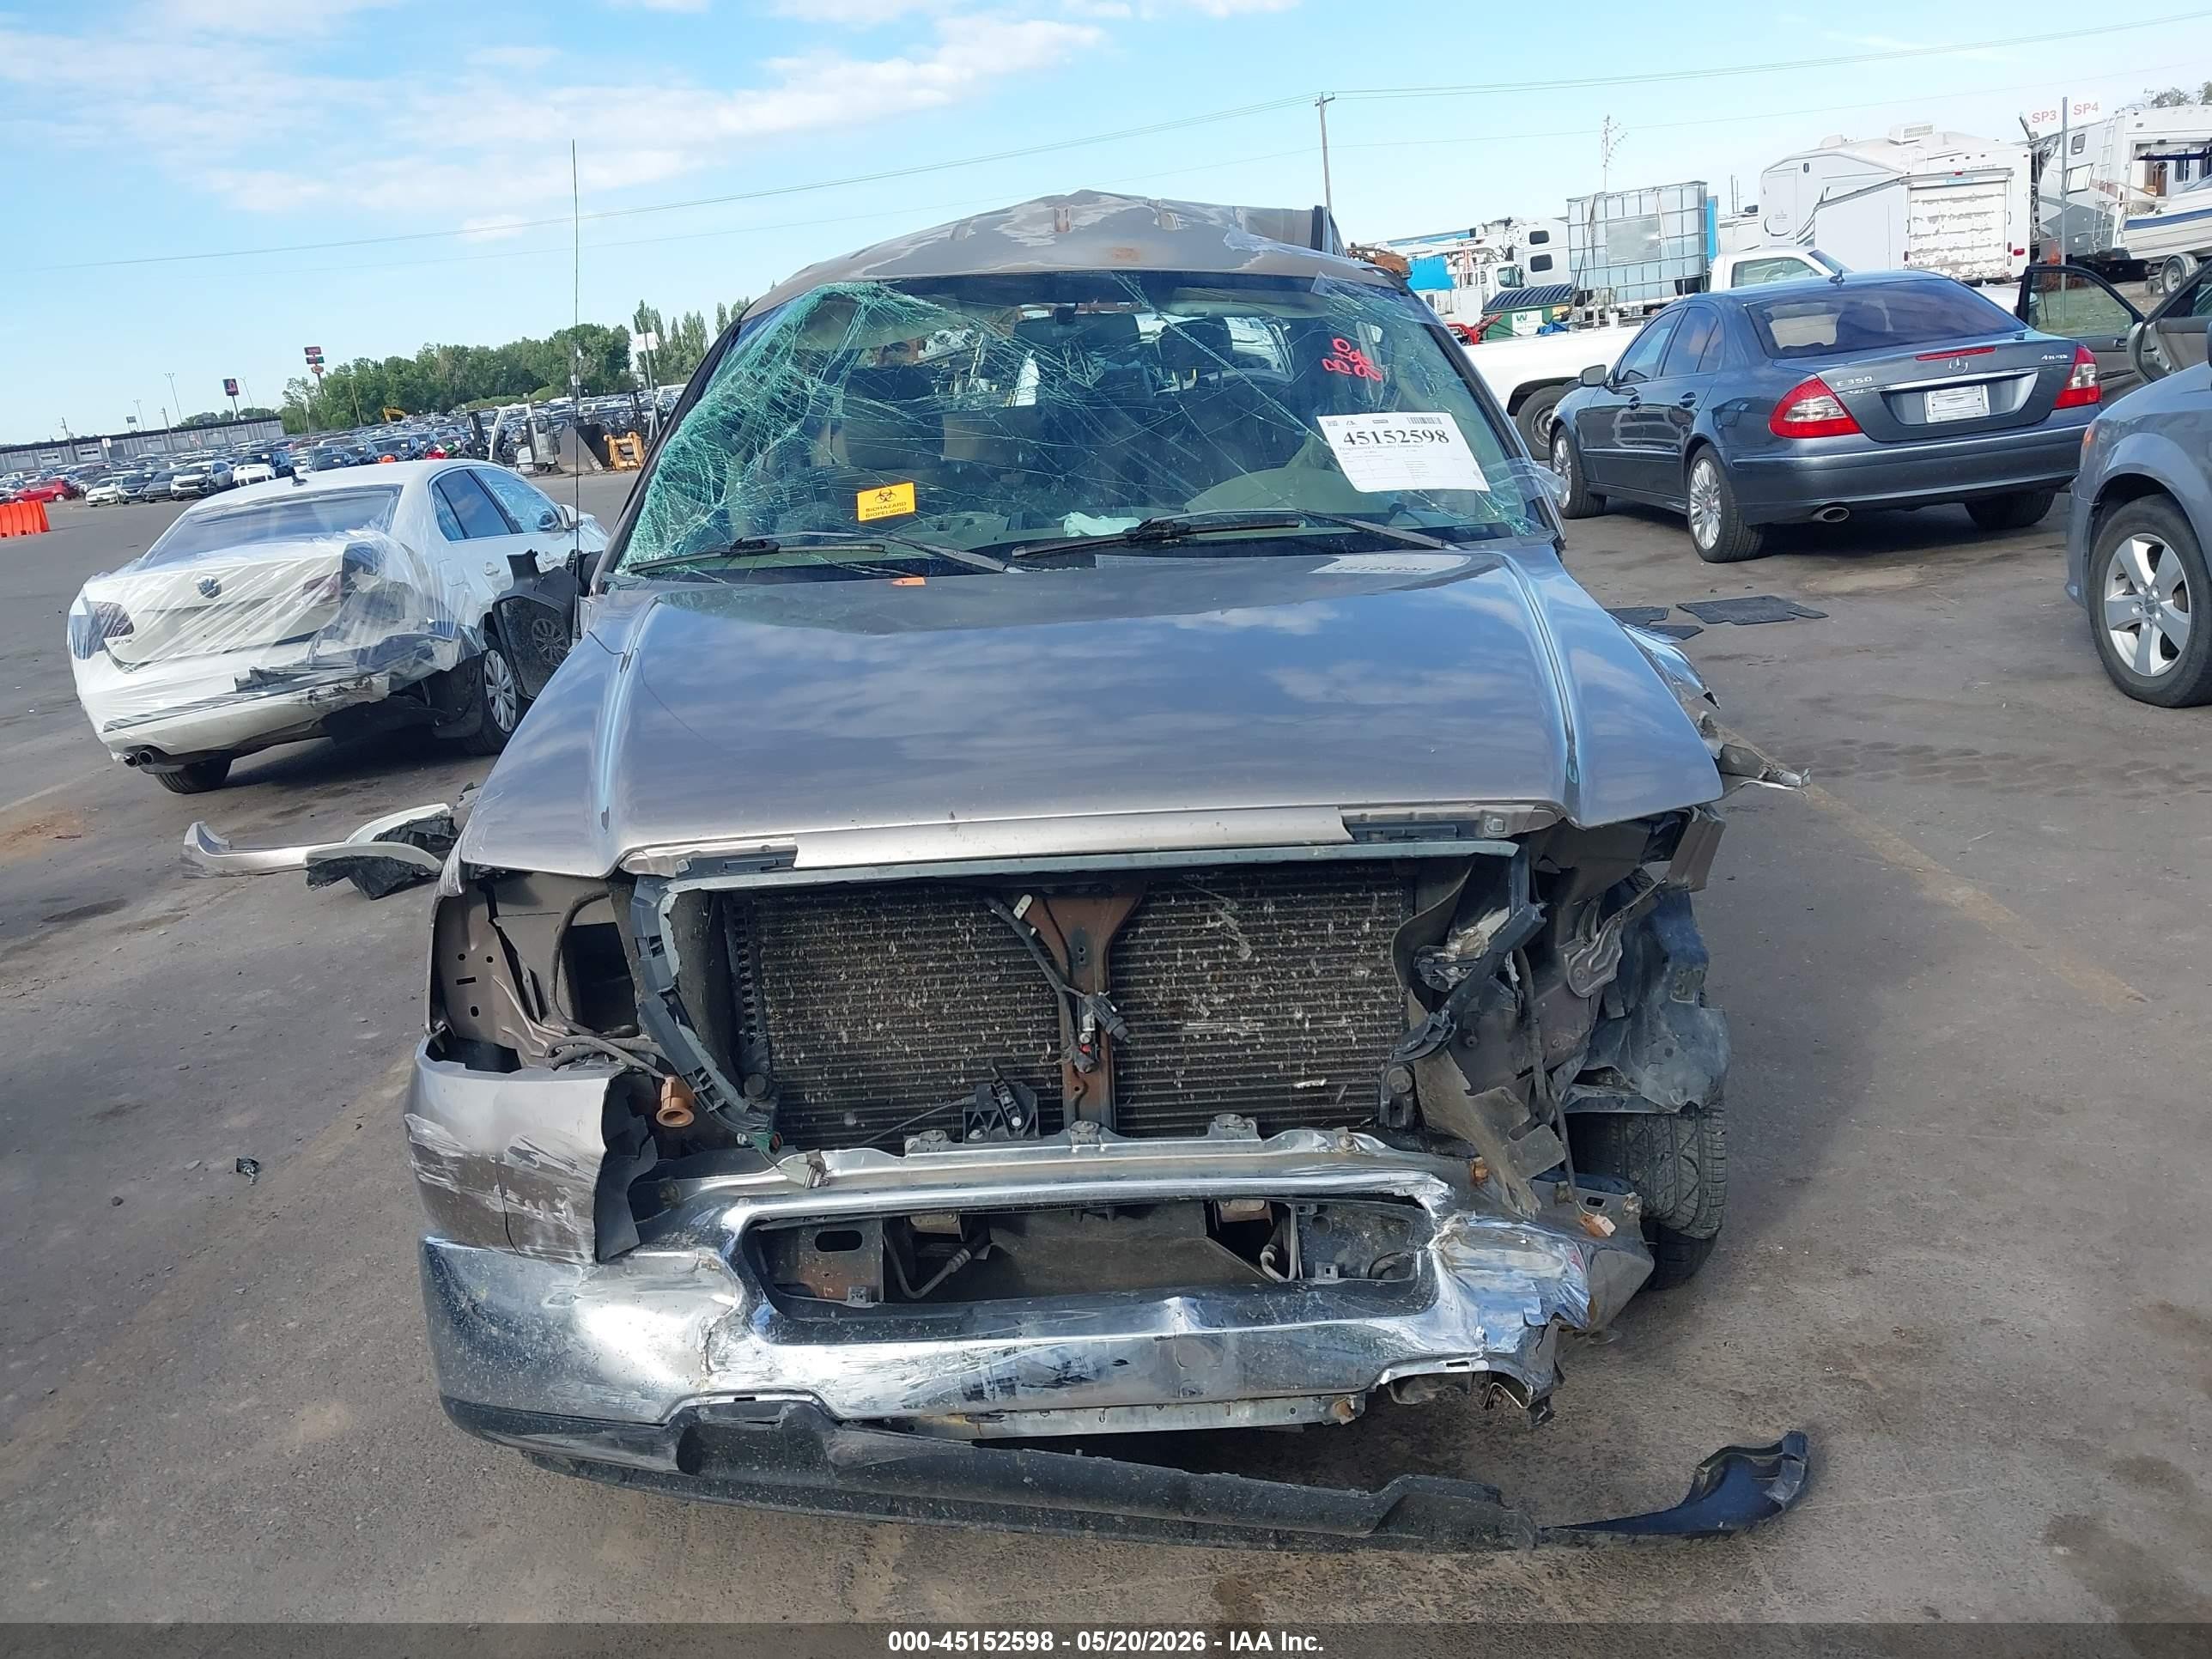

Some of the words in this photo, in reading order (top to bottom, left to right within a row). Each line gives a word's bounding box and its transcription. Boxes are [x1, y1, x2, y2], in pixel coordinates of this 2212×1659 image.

[2073, 102, 2100, 115] SP4
[2032, 110, 2057, 124] SP3
[1847, 375, 1873, 386] 350
[1343, 428, 1449, 446] 45152598
[866, 501, 907, 513] BIOHAZARD
